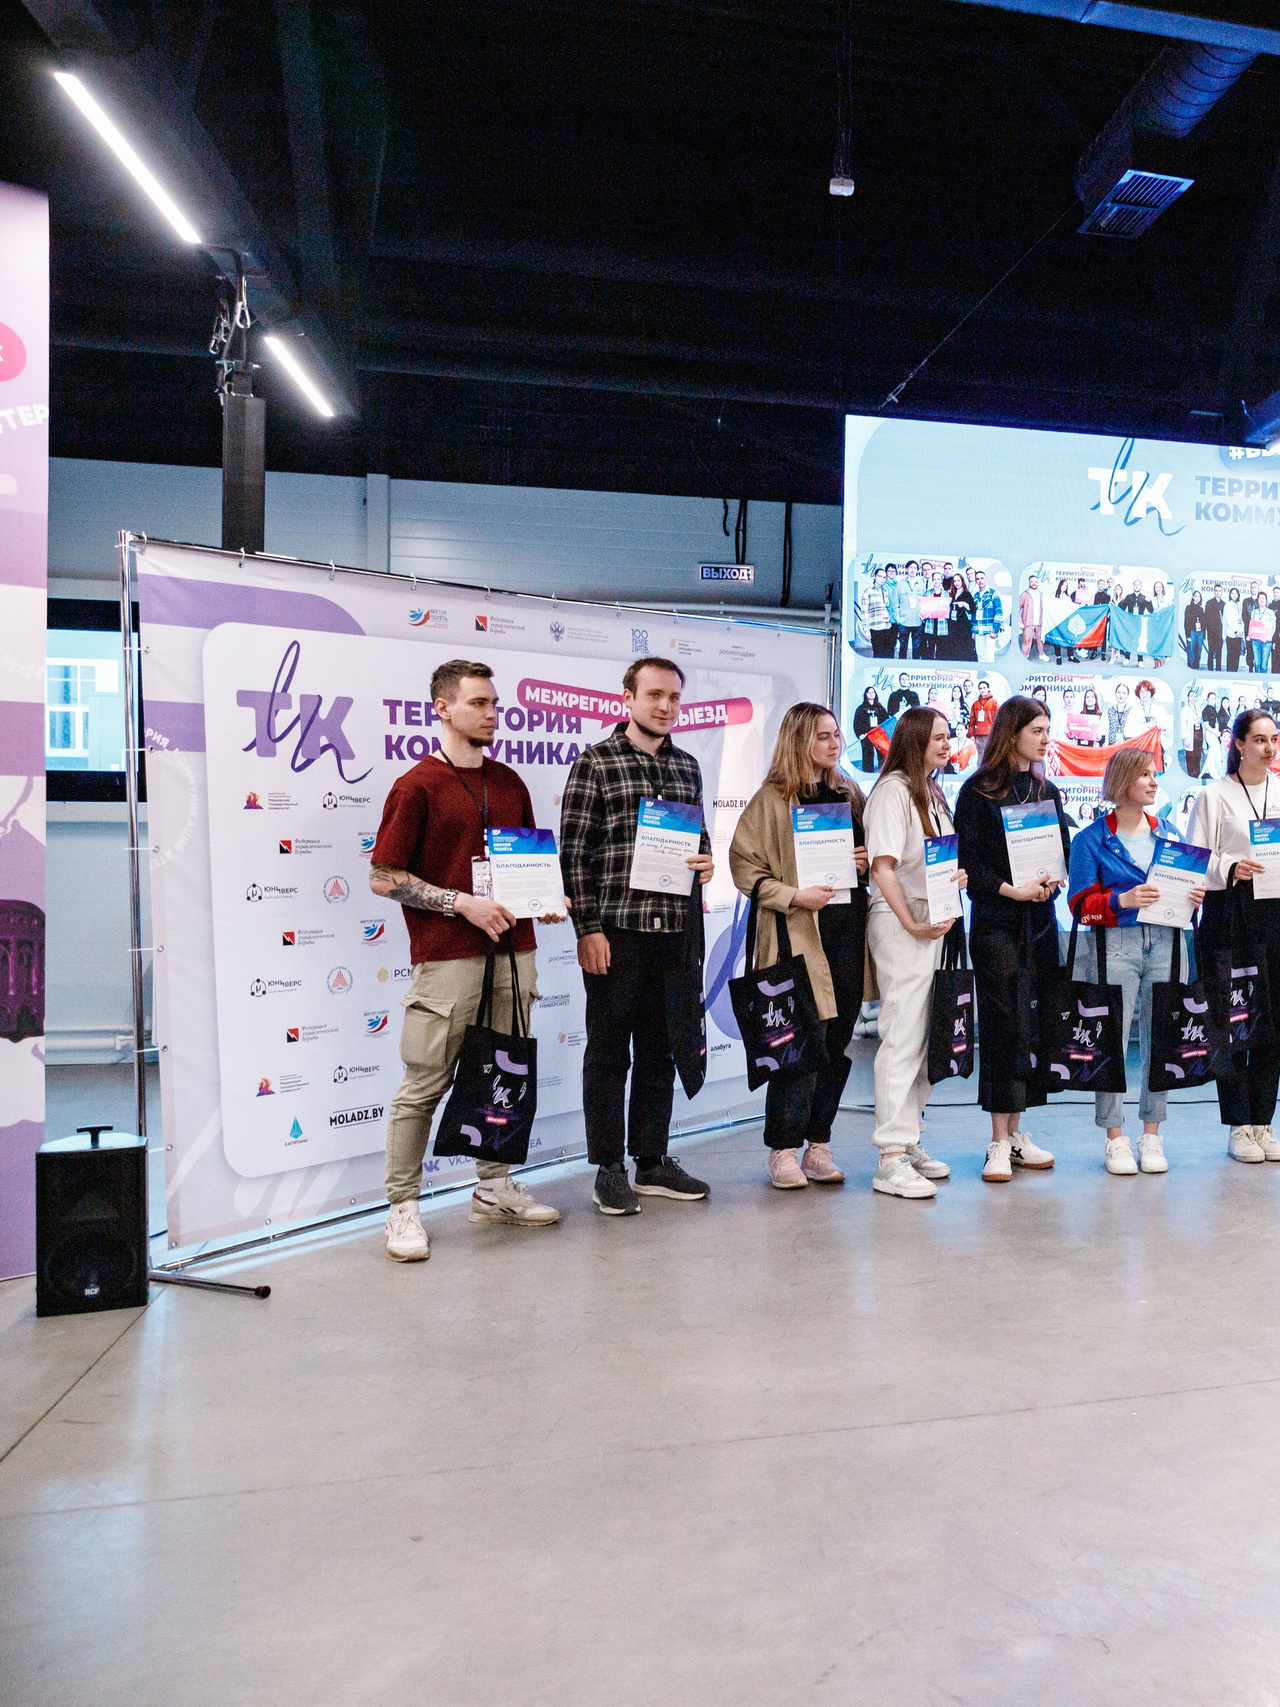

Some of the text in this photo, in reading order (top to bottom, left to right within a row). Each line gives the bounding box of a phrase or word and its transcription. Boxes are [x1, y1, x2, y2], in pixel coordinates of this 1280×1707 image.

[702, 567, 749, 580] ВЫХОД
[525, 686, 630, 717] МЕЖРЕГИОН
[383, 699, 581, 734] ТЕРОРИЯ
[713, 800, 747, 808] MOLADZ.BY
[641, 835, 691, 847] БЛАГОДАРНОСТЬ
[799, 838, 846, 846] БЛАГОДАРНОСТЬ
[1010, 834, 1054, 845] БЛАГОДАРНОСТЬ
[1154, 872, 1196, 885] БЛАГОДАРНОСТЬ
[540, 993, 571, 1001] ОВОЛЖСКИЙ
[710, 1043, 731, 1052] алабуга
[330, 1106, 384, 1126] MOLADZ.BY
[84, 1287, 100, 1296] RCF
